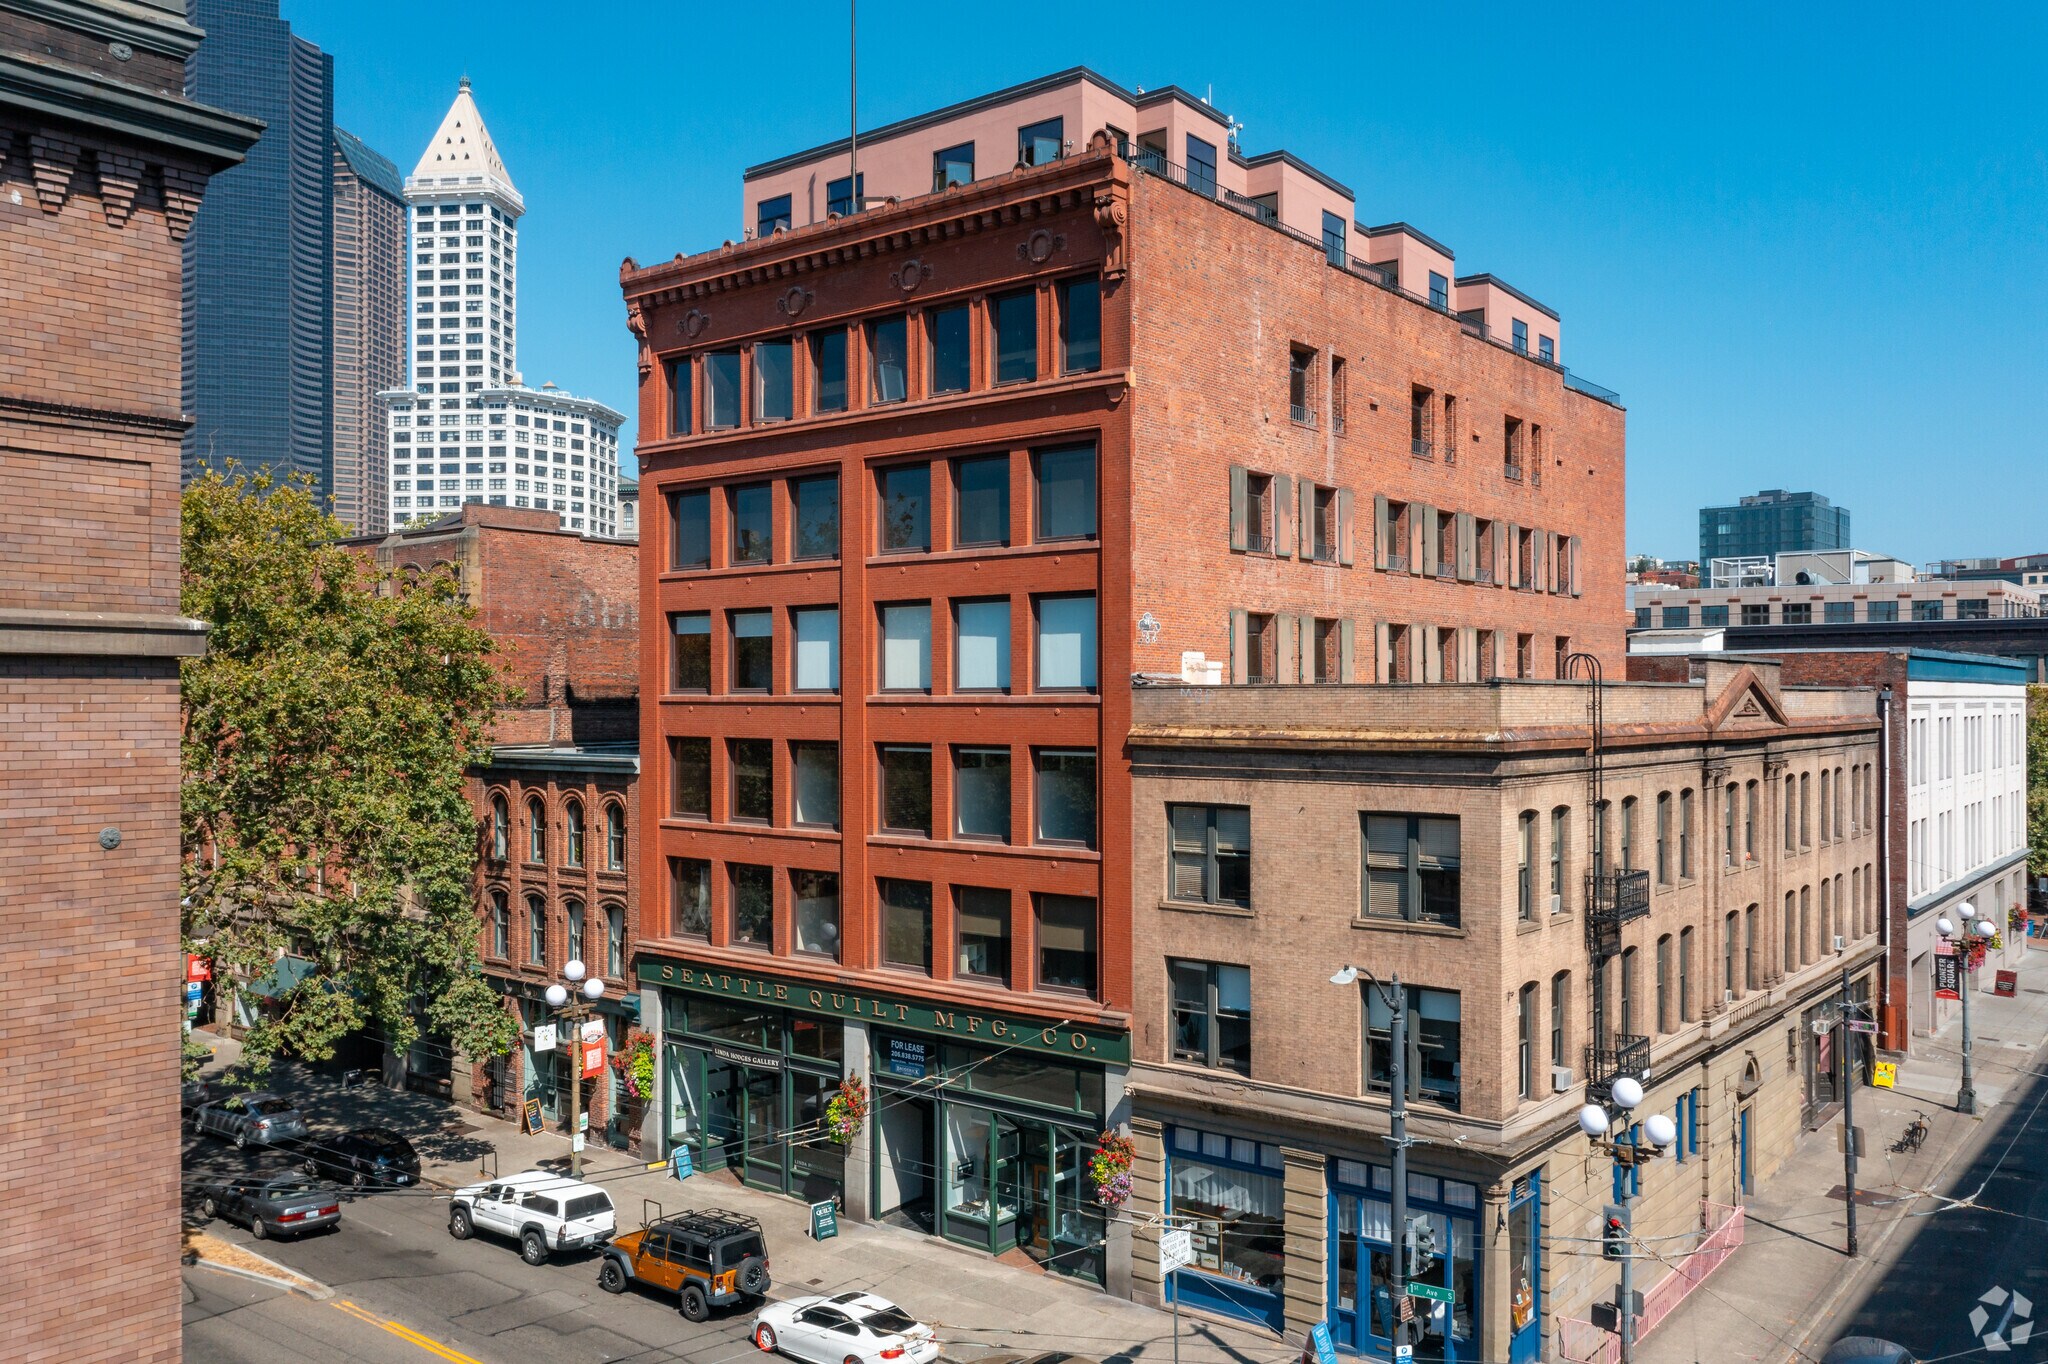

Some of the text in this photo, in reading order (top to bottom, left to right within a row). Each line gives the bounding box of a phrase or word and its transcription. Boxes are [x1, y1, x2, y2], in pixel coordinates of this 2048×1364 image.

[1938, 958, 1946, 988] PIONEER
[662, 965, 1096, 1053] SEATTLE QUILT MFG. CO.
[891, 1040, 924, 1054] FOR LEASE
[714, 1048, 780, 1067] LINDA HODGES GALLERY
[816, 1206, 832, 1216] QUILT
[1410, 1283, 1453, 1300] 1st Ave S
